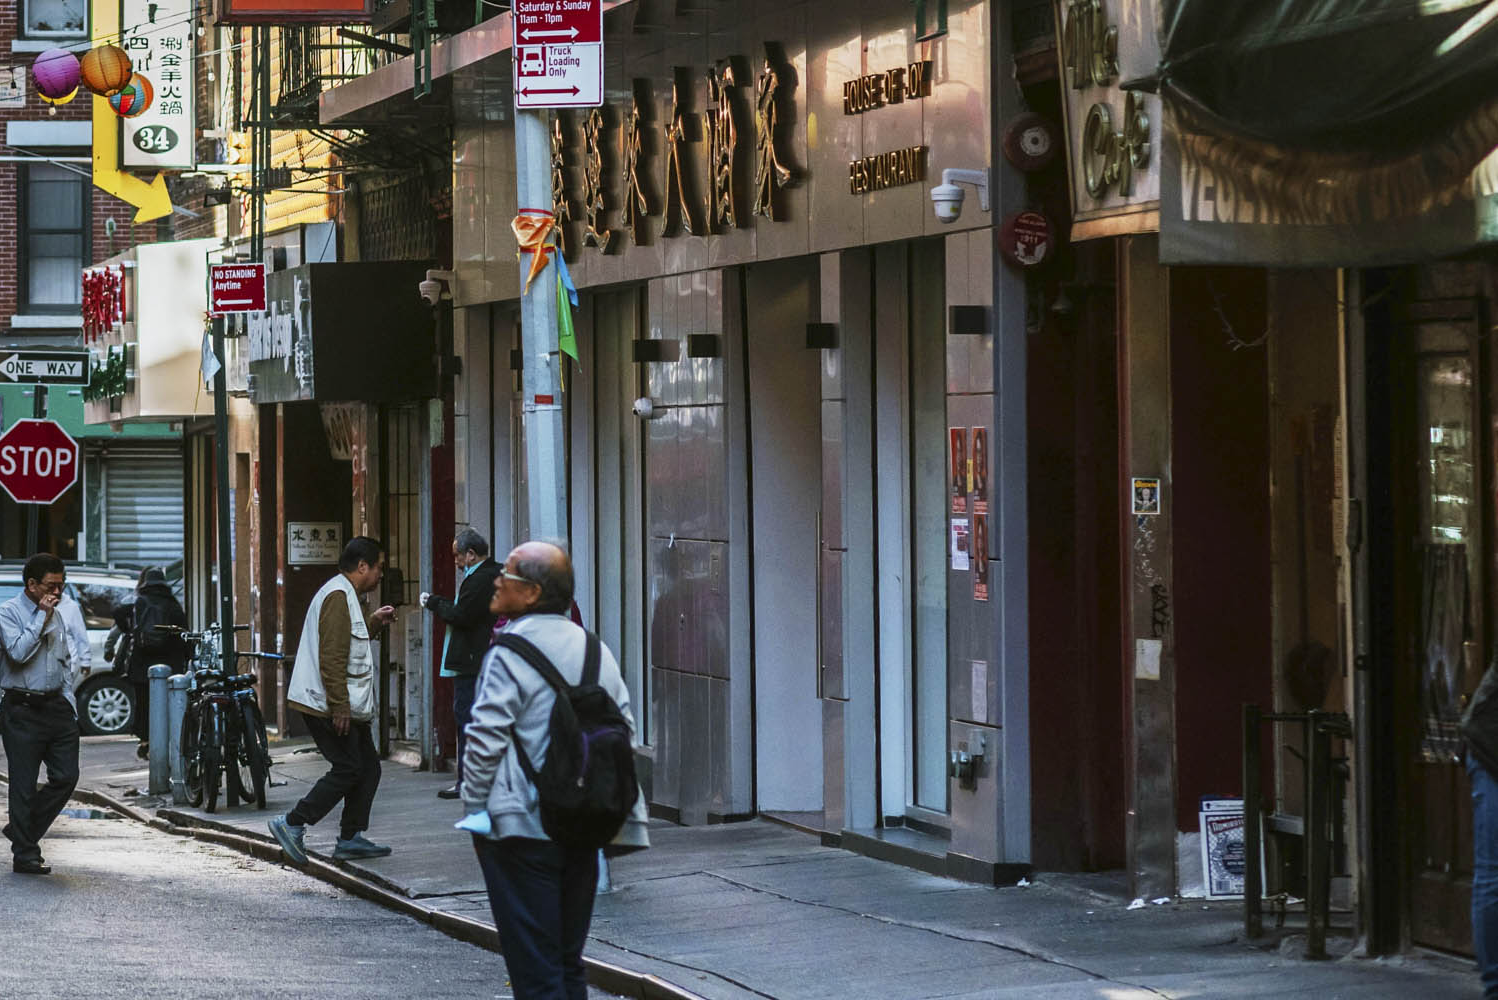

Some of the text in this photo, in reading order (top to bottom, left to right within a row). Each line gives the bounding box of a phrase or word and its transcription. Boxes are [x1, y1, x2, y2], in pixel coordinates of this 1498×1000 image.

[519, 0, 592, 13] Saturday & Sunday
[520, 14, 538, 24] 11am
[545, 13, 563, 25] 11pm
[549, 46, 572, 56] Truck
[548, 57, 581, 67] Loading
[549, 67, 567, 79] Only
[843, 62, 925, 115] HOUSE OF JOY
[139, 127, 170, 151] 34
[849, 146, 922, 195] RESTAURANT
[214, 268, 257, 280] NO STANDING
[215, 280, 242, 292] Anytime
[6, 361, 77, 376] ONE WAY
[0, 444, 73, 478] STOP
